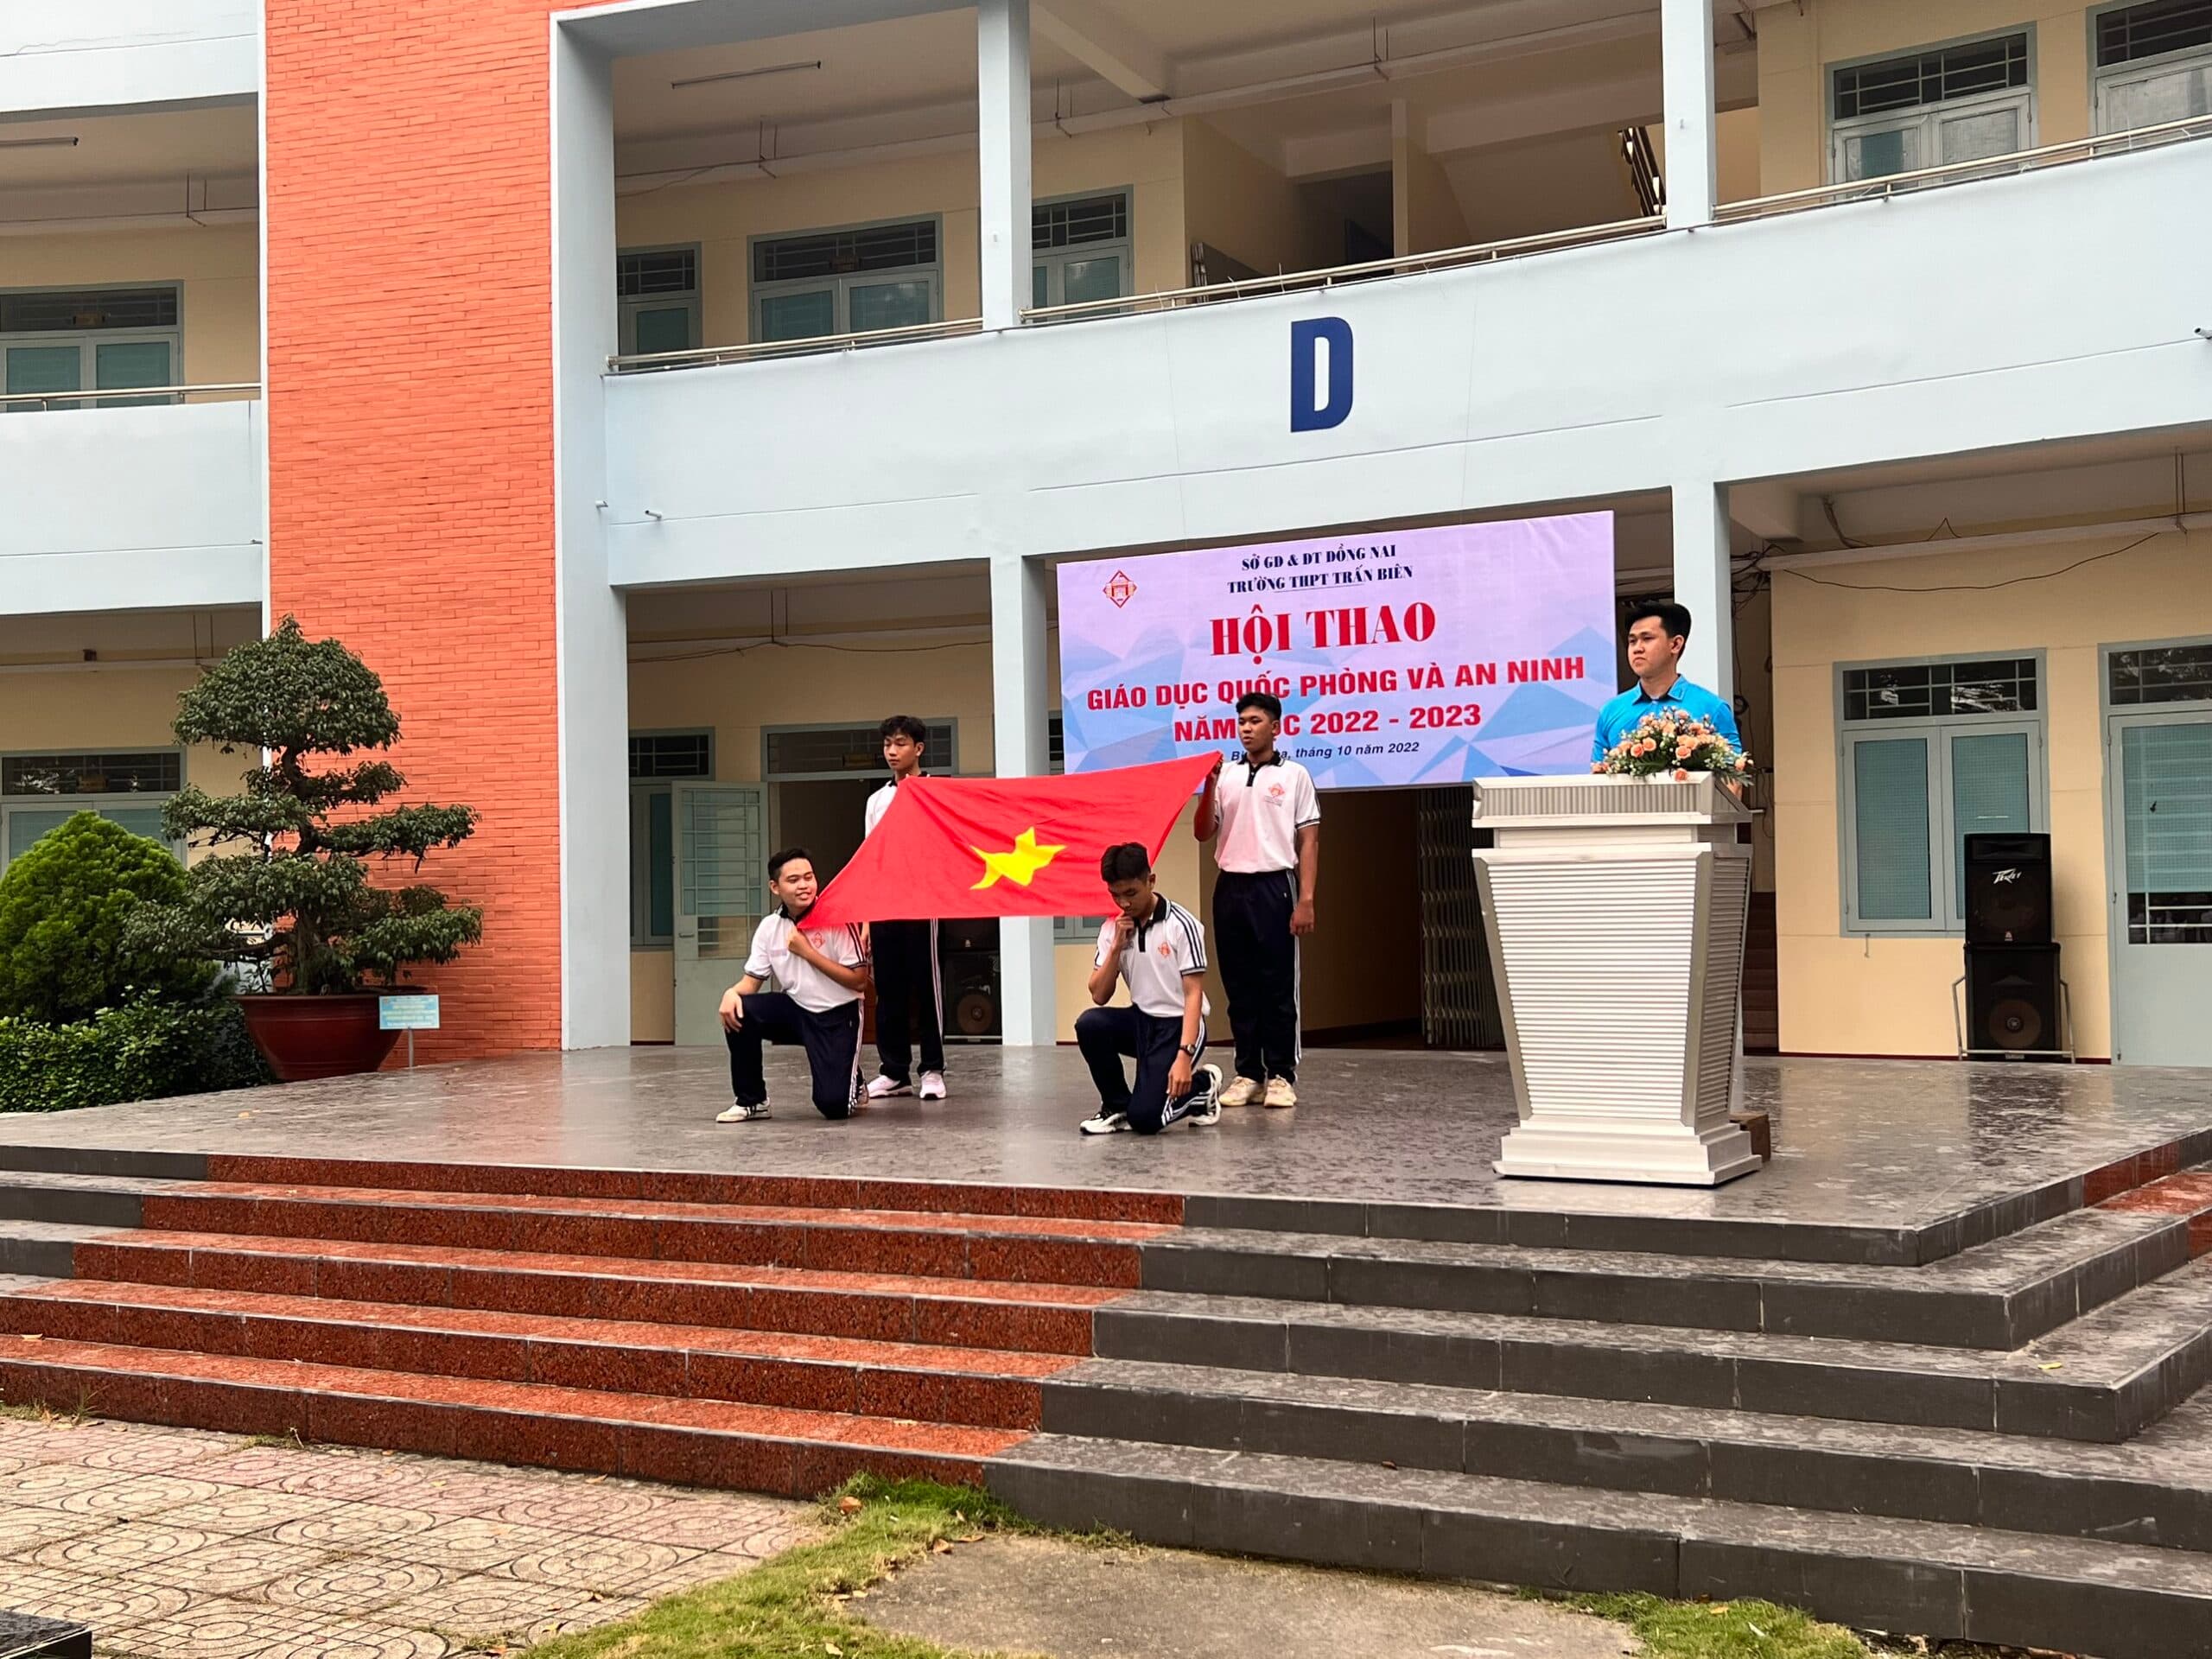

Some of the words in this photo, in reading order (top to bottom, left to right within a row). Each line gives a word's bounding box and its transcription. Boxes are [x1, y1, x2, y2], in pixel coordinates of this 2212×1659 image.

[1291, 316, 1353, 432] D
[1263, 556, 1284, 569] GD
[1287, 554, 1299, 566] &
[1370, 544, 1396, 559] NAI
[1227, 575, 1286, 594] TRƯỜNG
[1289, 574, 1329, 588] THPT
[1332, 564, 1374, 584] TRẤN
[1377, 563, 1414, 581] BIÊN
[1210, 604, 1293, 664] HỘI
[1306, 602, 1435, 648] THAO
[1087, 683, 1147, 710] GIÁO
[1156, 682, 1208, 709] DỤC
[1217, 671, 1291, 704] QUỐC
[1300, 667, 1397, 696] PHÒNG
[1407, 662, 1445, 690] VÀ
[1454, 663, 1497, 687] AN
[1508, 657, 1584, 683] NINH
[1174, 715, 1236, 741] NĂM
[1311, 710, 1379, 734] 2022
[1409, 704, 1482, 729] 2023
[1296, 747, 1332, 759] tháng
[1337, 746, 1351, 756] 10
[1355, 744, 1384, 755] năm
[1388, 741, 1420, 753] 2022
